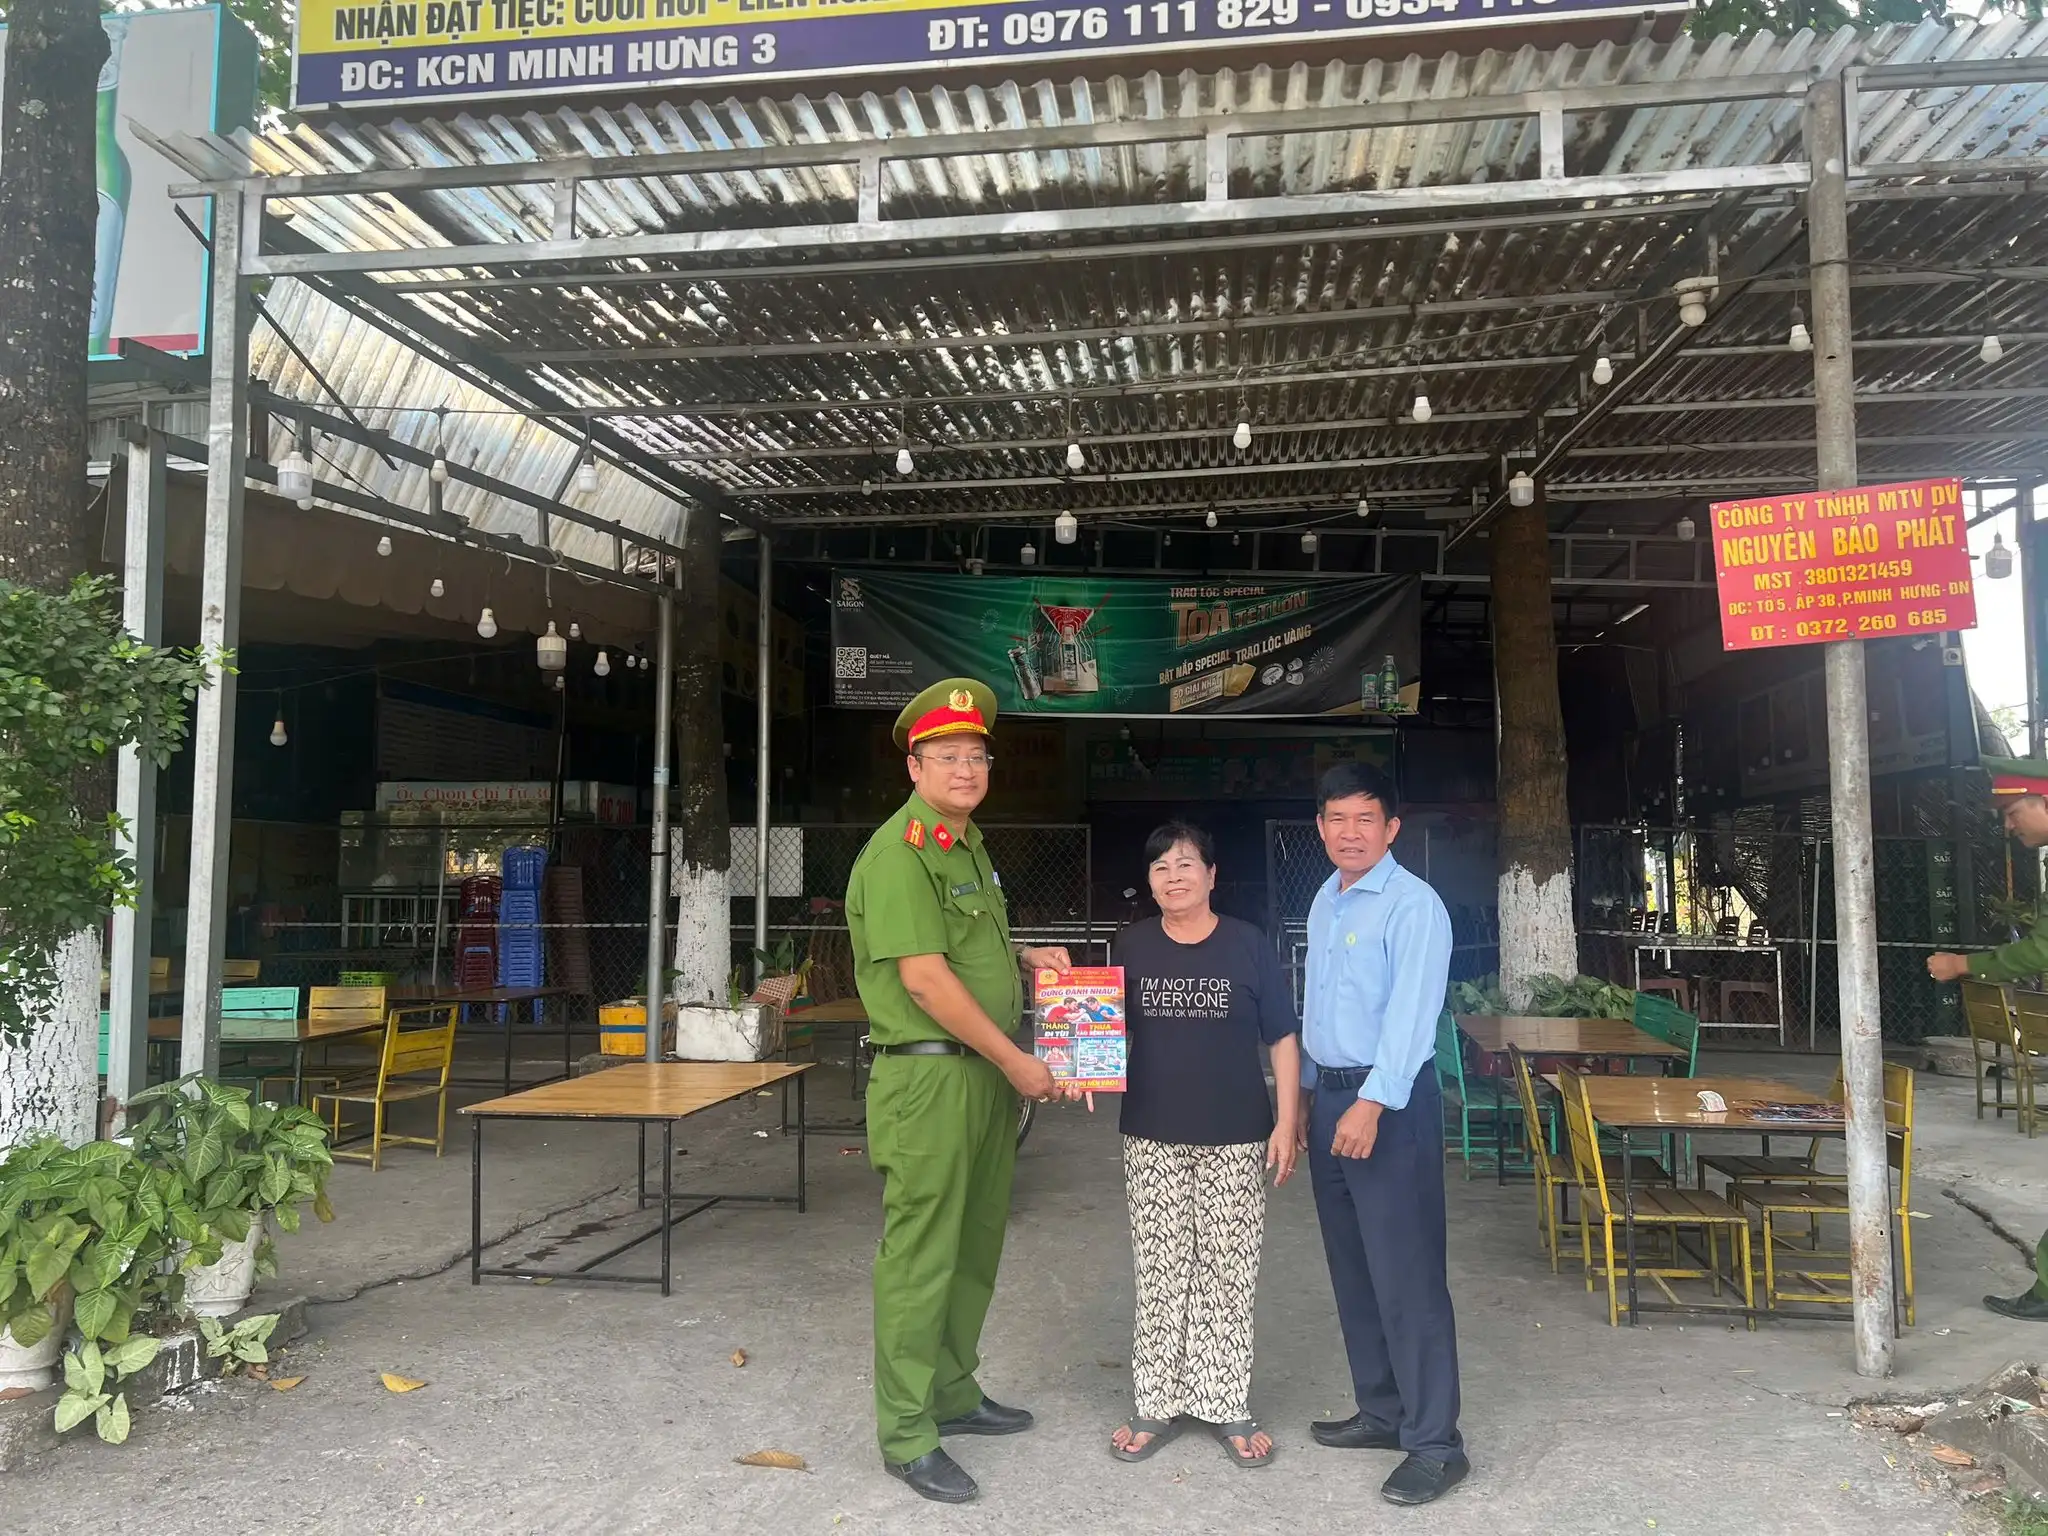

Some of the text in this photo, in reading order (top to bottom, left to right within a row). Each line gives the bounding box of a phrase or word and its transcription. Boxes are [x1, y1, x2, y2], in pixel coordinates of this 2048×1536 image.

[335, 0, 417, 44] NHẬN
[928, 16, 989, 51] ĐT:
[1003, 8, 1108, 46] 0976
[1124, 1, 1197, 36] 111
[1217, 0, 1299, 29] 829
[341, 33, 776, 91] ĐC: KCN MINH HƯNG 3
[1717, 484, 1958, 529] CÔNG TY TNHH MTV DV
[1721, 508, 1956, 568] NGUYÊN BẢO PHÁT
[1169, 587, 1197, 598] TRAO
[1223, 586, 1267, 597] SPECIAL
[1753, 559, 1913, 592] MST 3801321459
[1728, 601, 1752, 616] ĐC:
[1796, 618, 1849, 637] 0372
[1858, 614, 1897, 631] 260
[1907, 609, 1947, 626] 685
[1194, 649, 1232, 671] SPECIAL
[1235, 645, 1260, 663] TRAO
[1262, 636, 1281, 653] LỘC
[1283, 624, 1313, 645] VÀNG
[1140, 977, 1232, 992] I'M NOT FOR
[1141, 991, 1229, 1009] EVERYONE
[1144, 1008, 1158, 1017] AND
[1162, 1009, 1173, 1017] AM
[1175, 1009, 1187, 1018] OK
[1188, 1009, 1208, 1018] WITH
[1209, 1010, 1229, 1019] THAT
